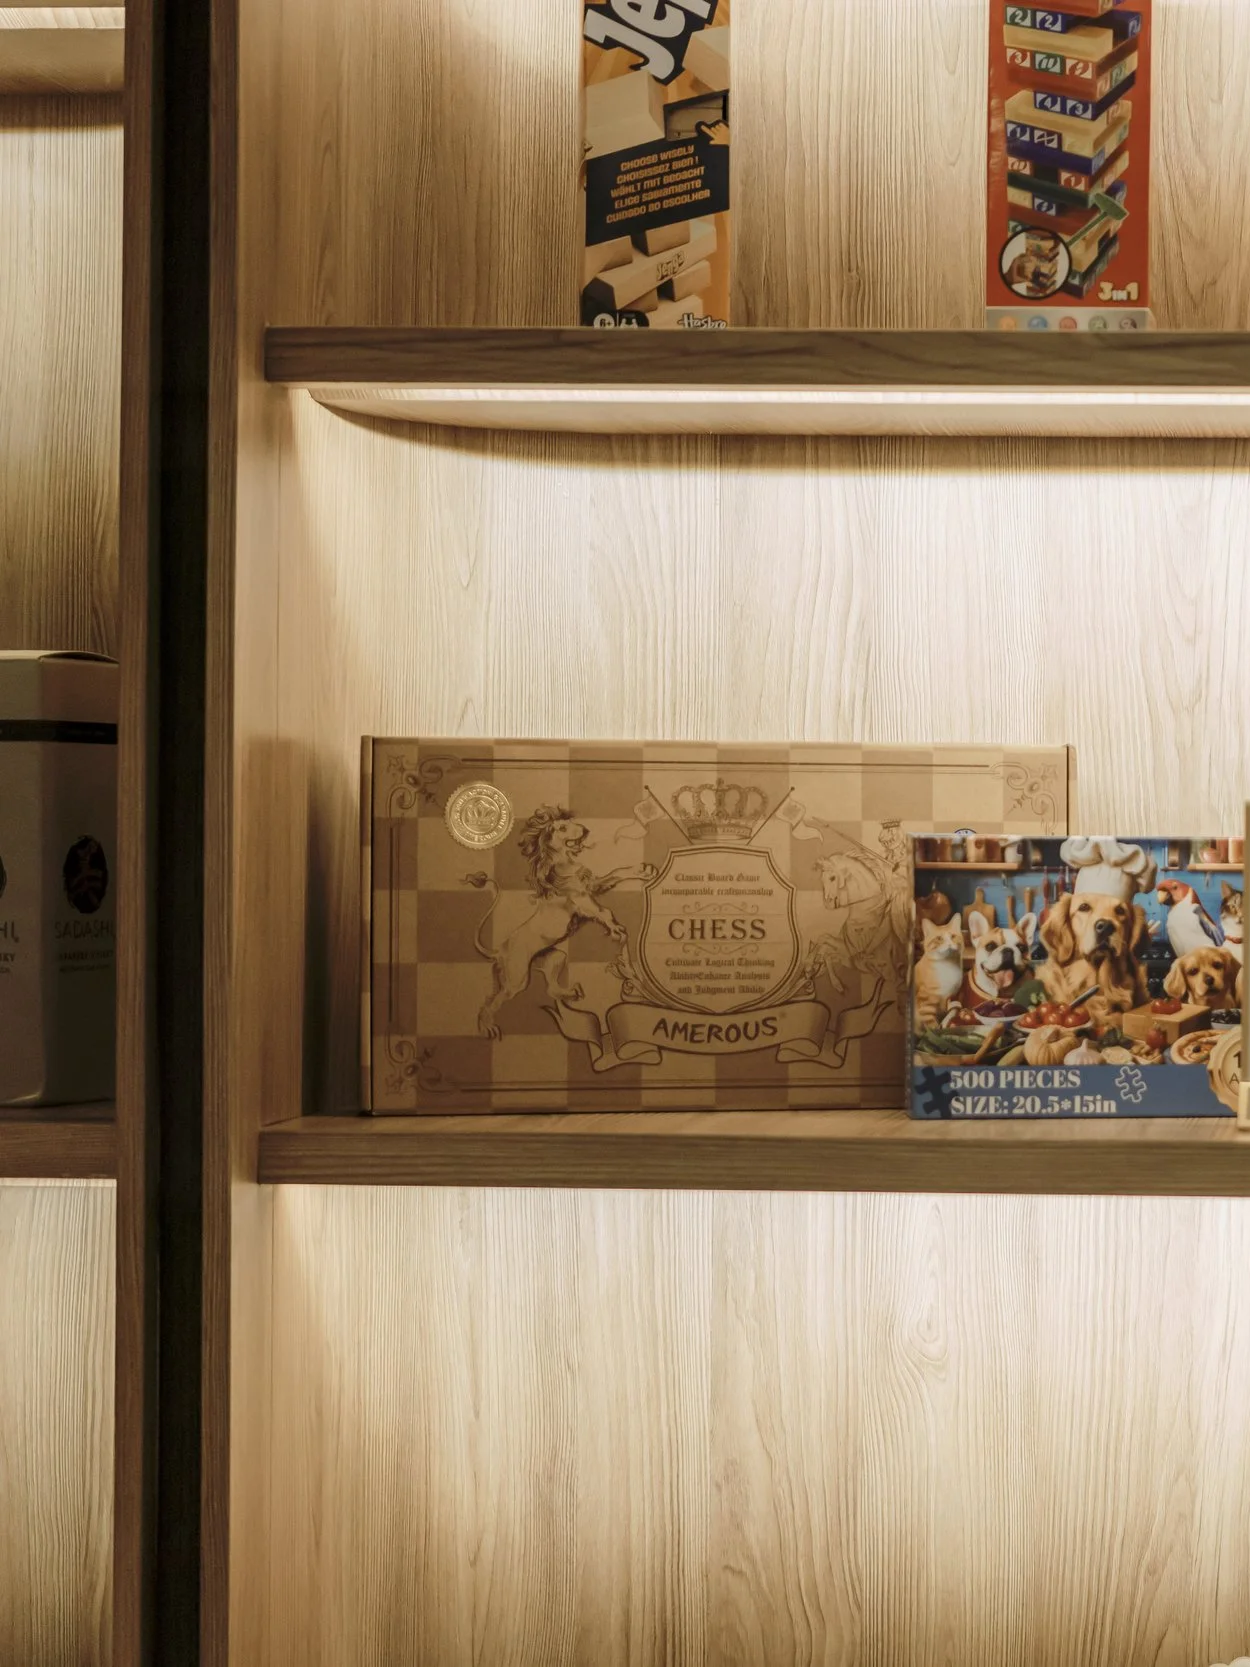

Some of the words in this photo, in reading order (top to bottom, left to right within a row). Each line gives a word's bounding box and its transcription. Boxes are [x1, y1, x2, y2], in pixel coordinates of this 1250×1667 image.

[656, 251, 685, 281] Jenga
[678, 313, 728, 328] Hasbro
[668, 918, 766, 940] CHESS
[652, 1016, 778, 1043] AMEROUS
[950, 1070, 994, 1089] 500
[999, 1069, 1081, 1089] PIECES
[951, 1095, 1009, 1115] SIZE:
